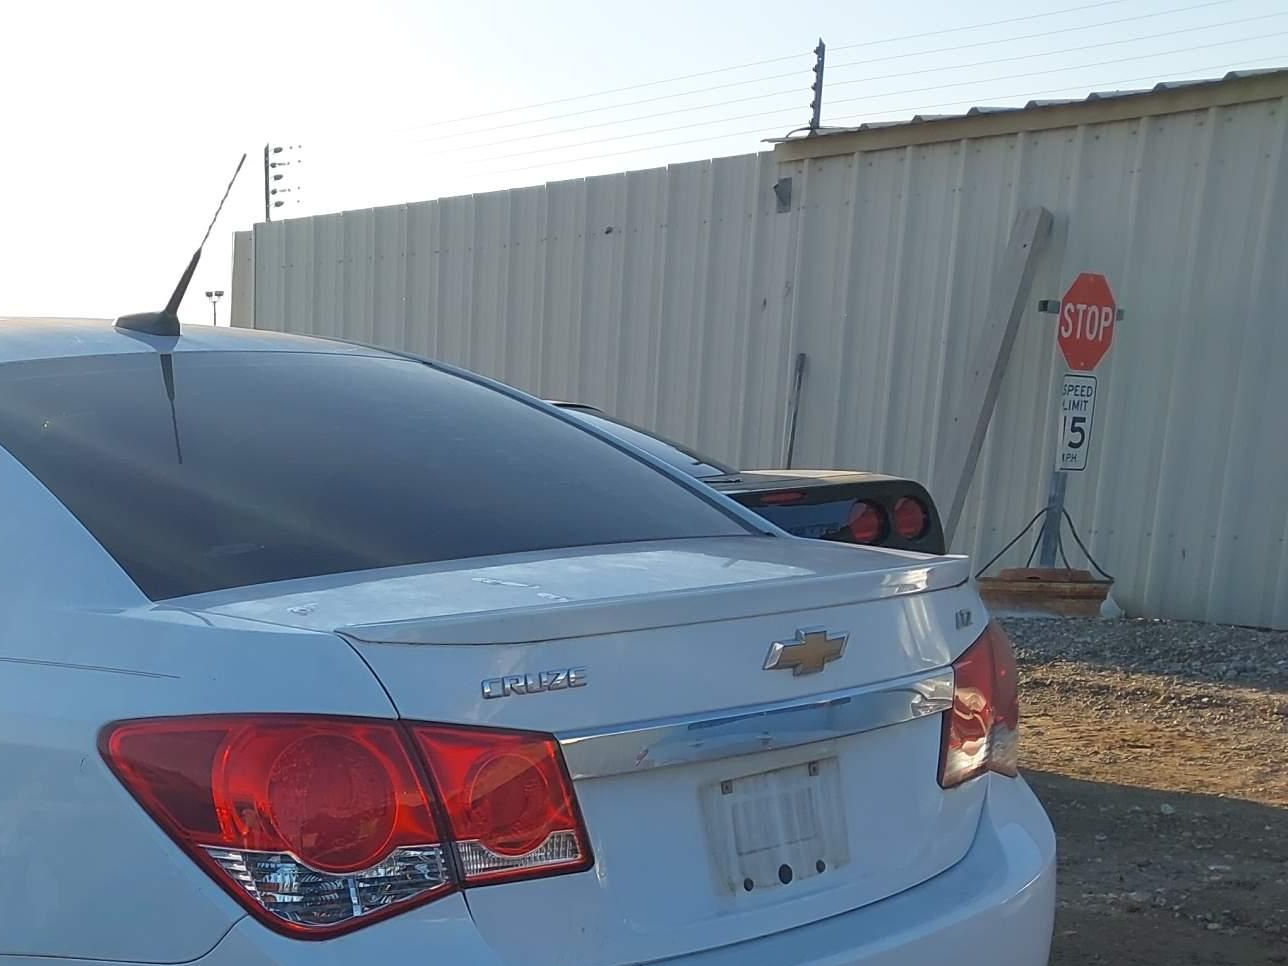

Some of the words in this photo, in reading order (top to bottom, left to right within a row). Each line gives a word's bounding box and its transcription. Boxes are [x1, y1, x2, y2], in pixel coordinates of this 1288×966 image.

[1061, 303, 1113, 341] STOP
[1063, 384, 1093, 397] SPEED
[1063, 399, 1089, 411] LIMIT
[481, 665, 587, 699] CRUZE
